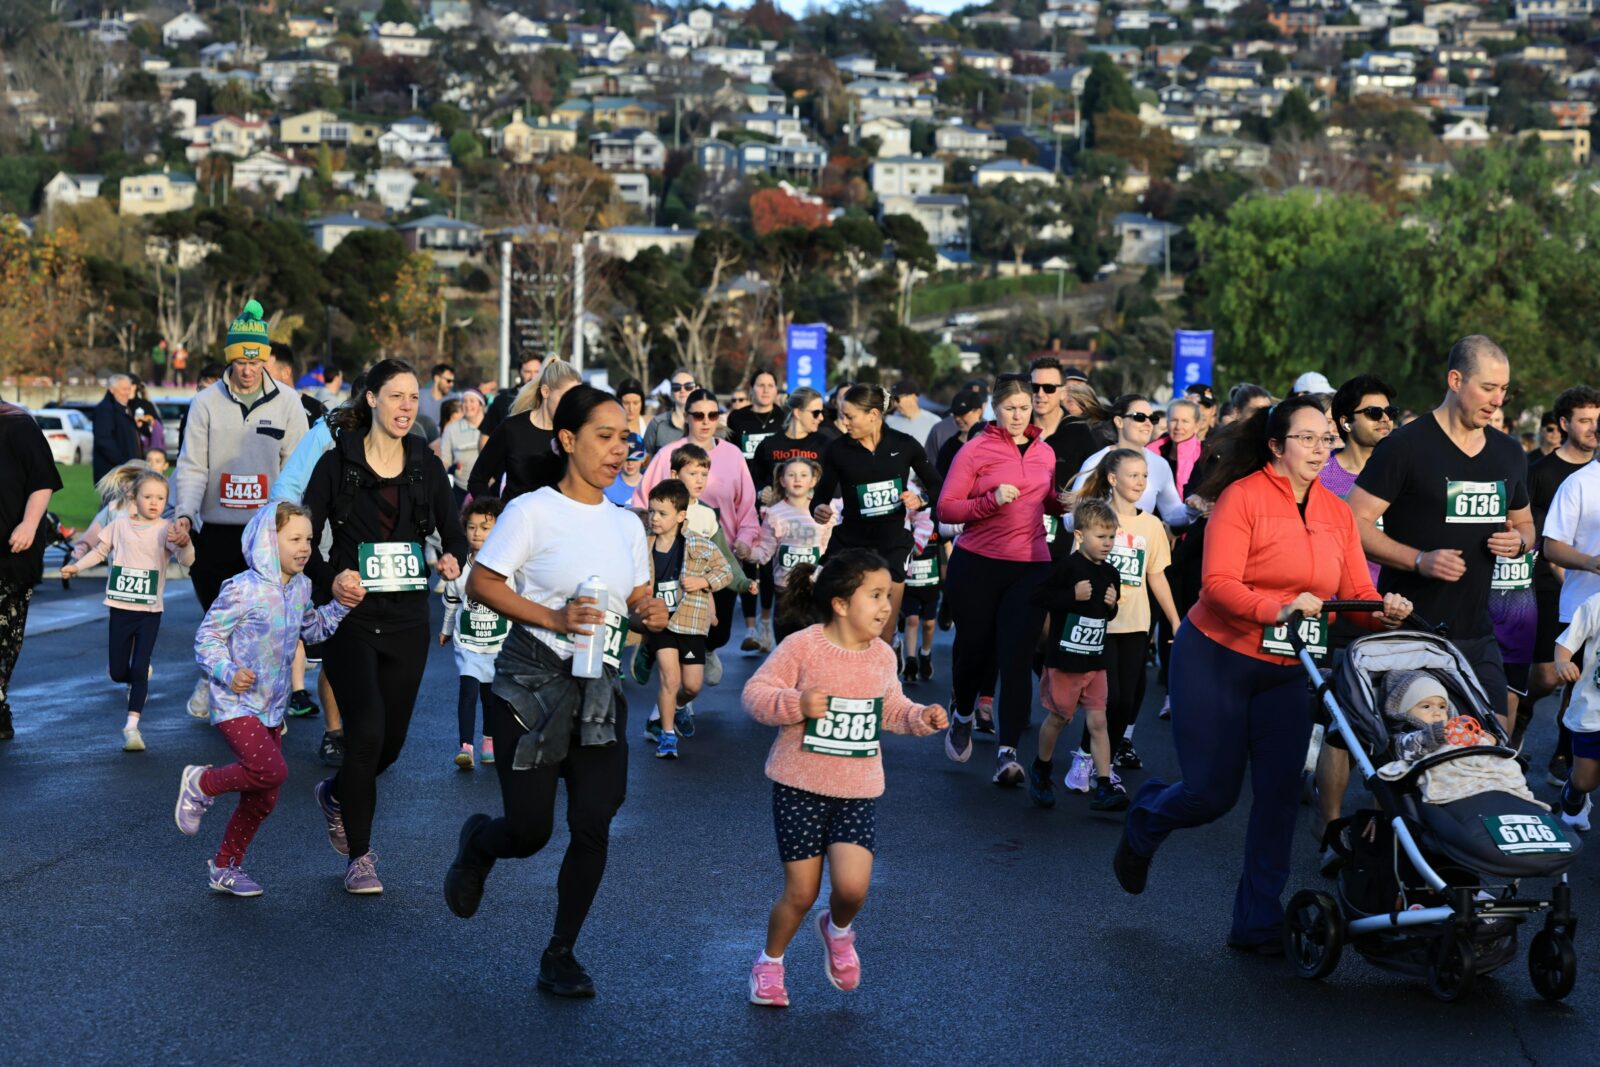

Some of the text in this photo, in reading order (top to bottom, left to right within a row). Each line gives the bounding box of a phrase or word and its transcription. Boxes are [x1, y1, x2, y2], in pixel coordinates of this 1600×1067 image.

[225, 483, 262, 499] 5443
[863, 487, 899, 508] 6328
[1455, 494, 1500, 516] 6136
[366, 555, 420, 578] 6339
[116, 575, 151, 594] 6241
[470, 620, 497, 630] SANAA
[1273, 620, 1321, 645] 645
[815, 711, 877, 741] 6383
[1498, 824, 1557, 843] 6146
